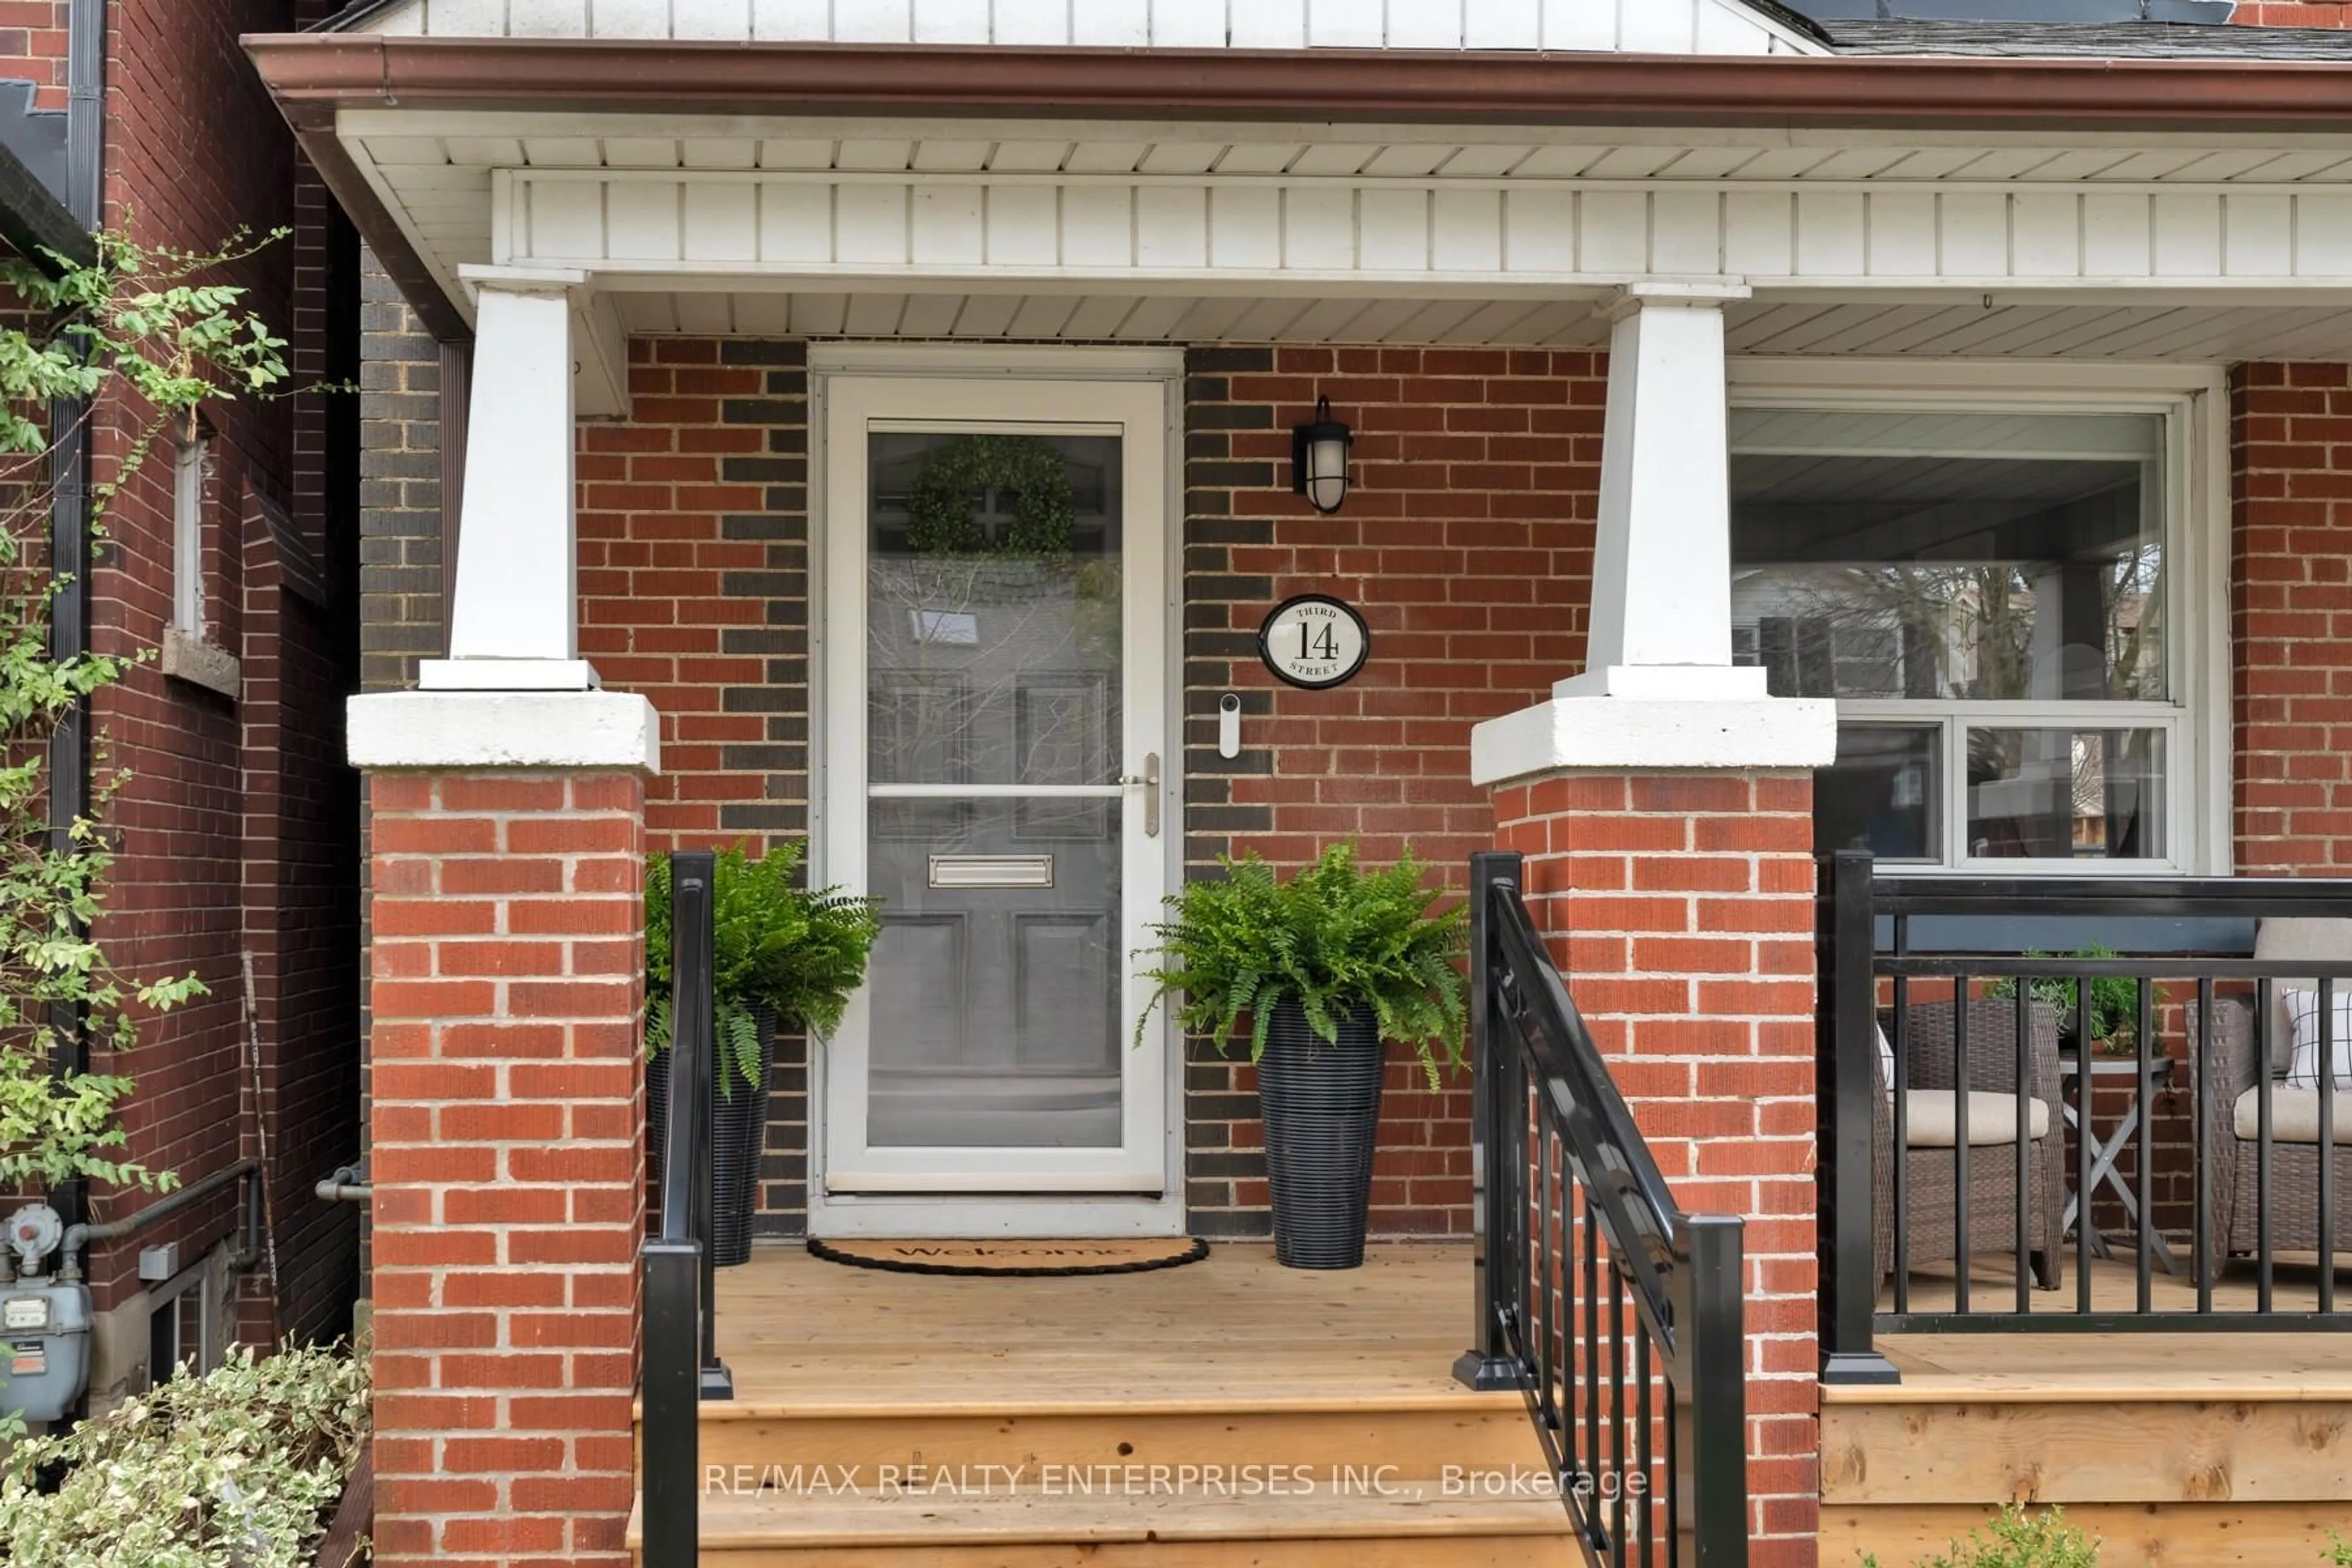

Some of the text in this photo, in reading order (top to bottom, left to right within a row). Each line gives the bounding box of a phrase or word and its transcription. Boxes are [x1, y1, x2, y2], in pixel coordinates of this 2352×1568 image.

[1297, 607, 1336, 619] THIRD
[1294, 622, 1339, 660] 14
[1289, 662, 1338, 676] STREET
[894, 1247, 1137, 1256] Welcome
